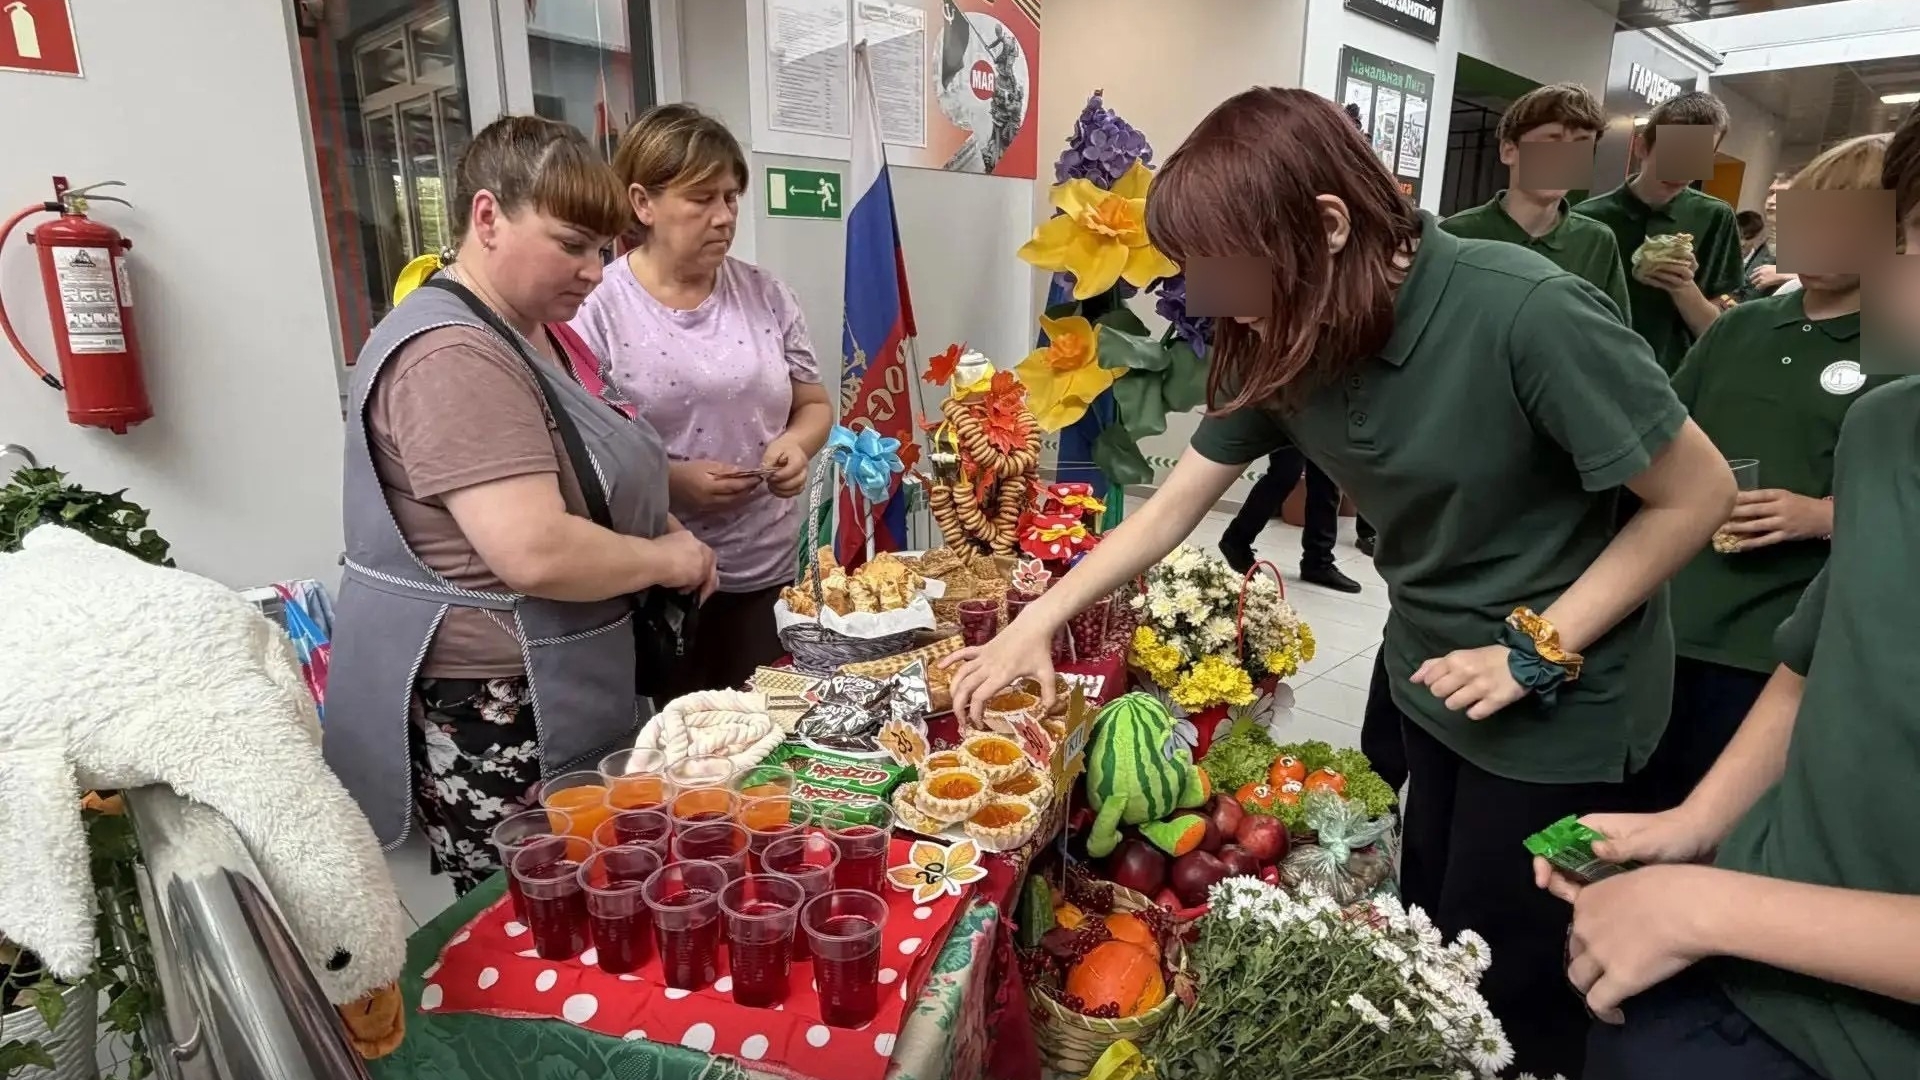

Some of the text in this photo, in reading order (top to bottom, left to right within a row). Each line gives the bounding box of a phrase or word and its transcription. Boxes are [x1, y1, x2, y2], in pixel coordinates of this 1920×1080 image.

[971, 69, 995, 92] МАЯ
[1351, 55, 1426, 94] Начальная Лига
